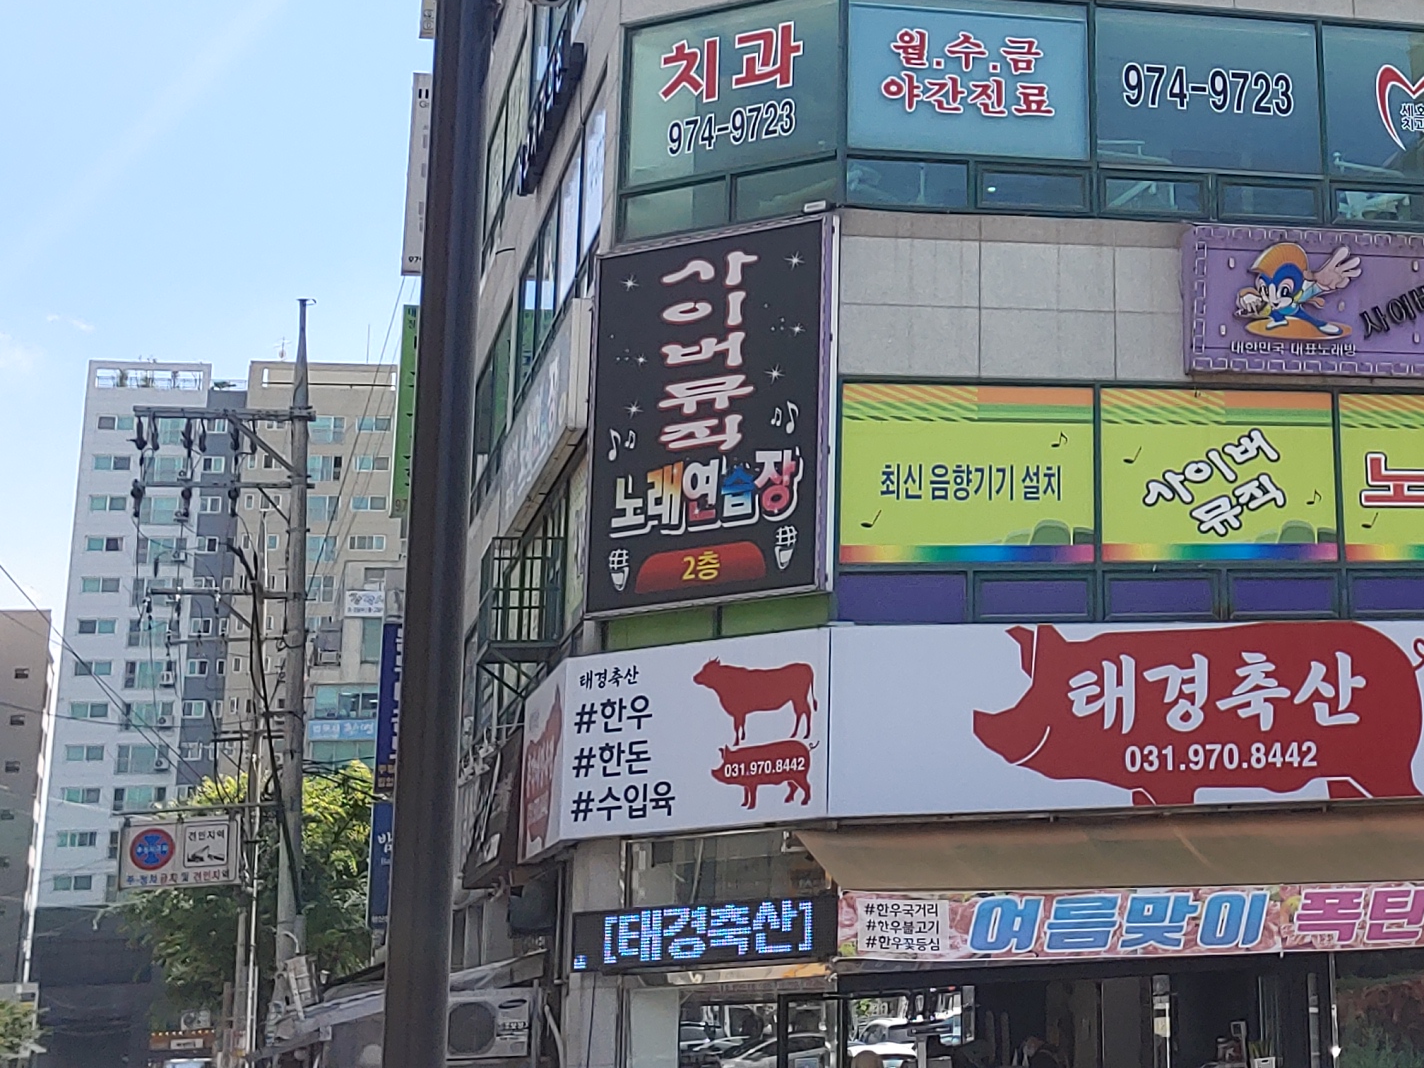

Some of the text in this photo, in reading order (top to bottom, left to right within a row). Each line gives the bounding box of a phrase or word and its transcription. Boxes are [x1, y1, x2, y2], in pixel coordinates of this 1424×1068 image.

[659, 21, 803, 104] 치과
[881, 74, 1055, 119] 야간진료
[1122, 62, 1294, 118] 974-9723
[667, 97, 797, 157] 974-9723
[880, 463, 1063, 502] 최신 음향기기 설치
[1142, 427, 1281, 507] 사이버
[609, 447, 804, 539] 노래연습장
[1190, 473, 1287, 537] 뮤직
[682, 550, 721, 583] 2층
[579, 665, 639, 689] 태경축산
[1068, 650, 1367, 735] 태경축산
[574, 695, 652, 734] #한우
[572, 740, 651, 778] #한돈
[724, 755, 805, 779] 031.970.8442
[1124, 740, 1318, 773] 031.970.8442
[571, 781, 675, 822] #수입육
[967, 891, 1269, 954] 여름맞이
